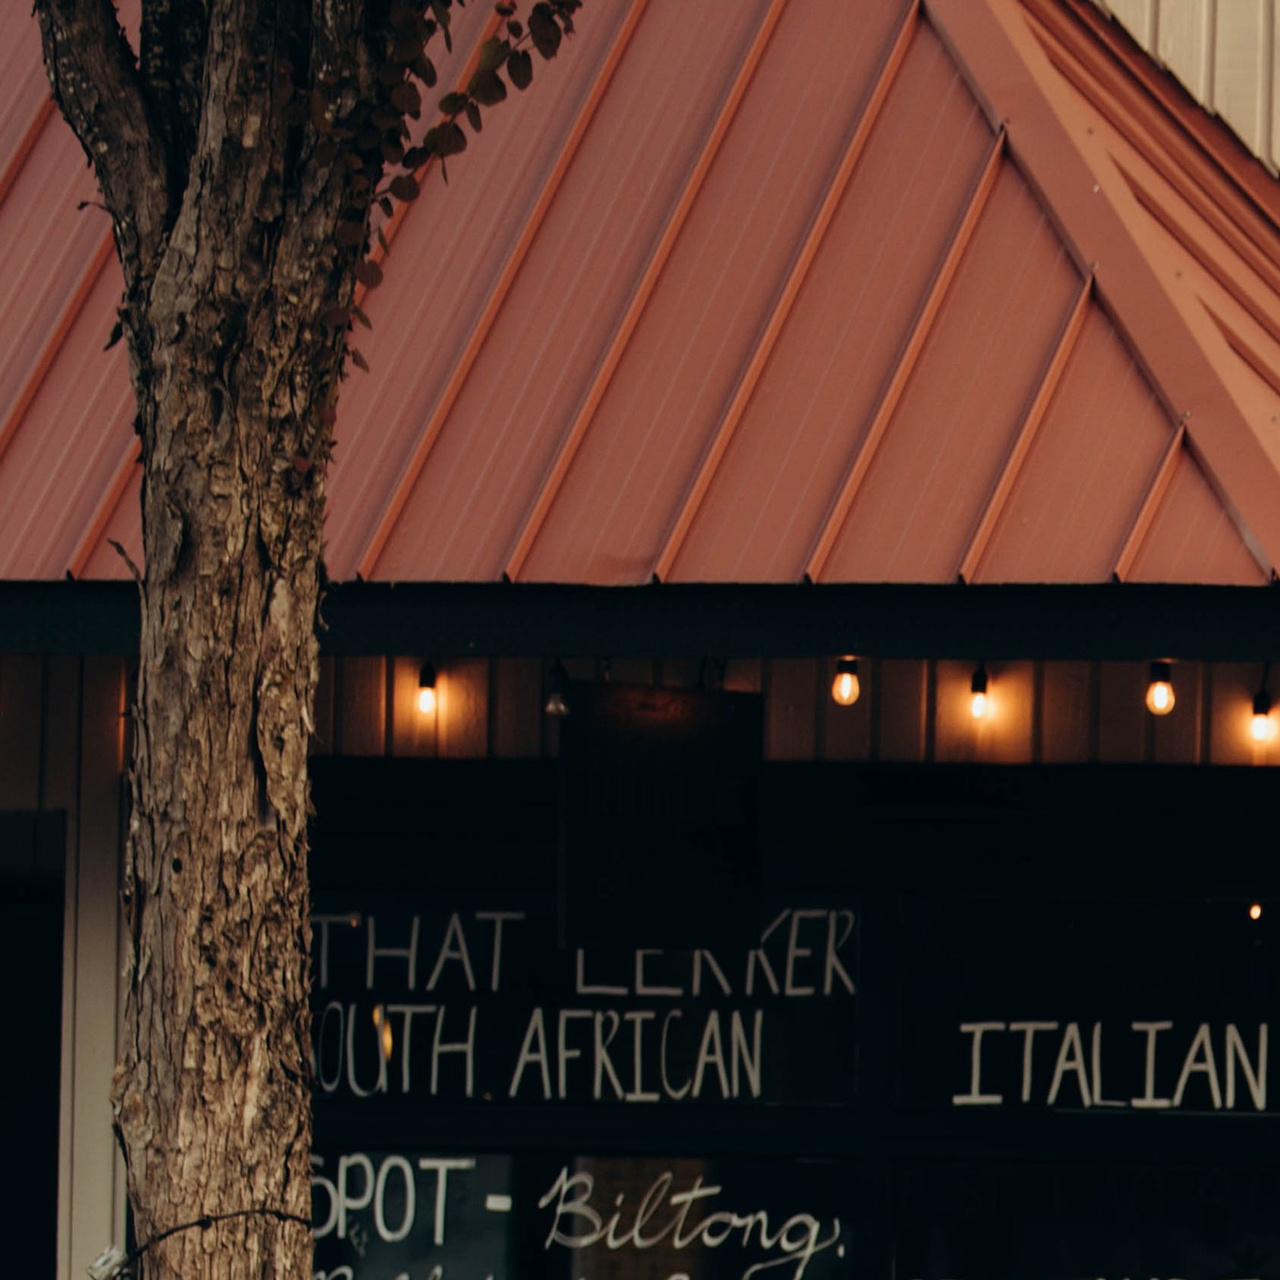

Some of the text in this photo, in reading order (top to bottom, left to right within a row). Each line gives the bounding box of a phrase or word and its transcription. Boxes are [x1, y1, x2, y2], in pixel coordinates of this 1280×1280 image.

[309, 911, 525, 992] THAT
[310, 1001, 764, 1102] OUTH AFRICAN
[953, 1020, 1268, 1111] ITALIAN
